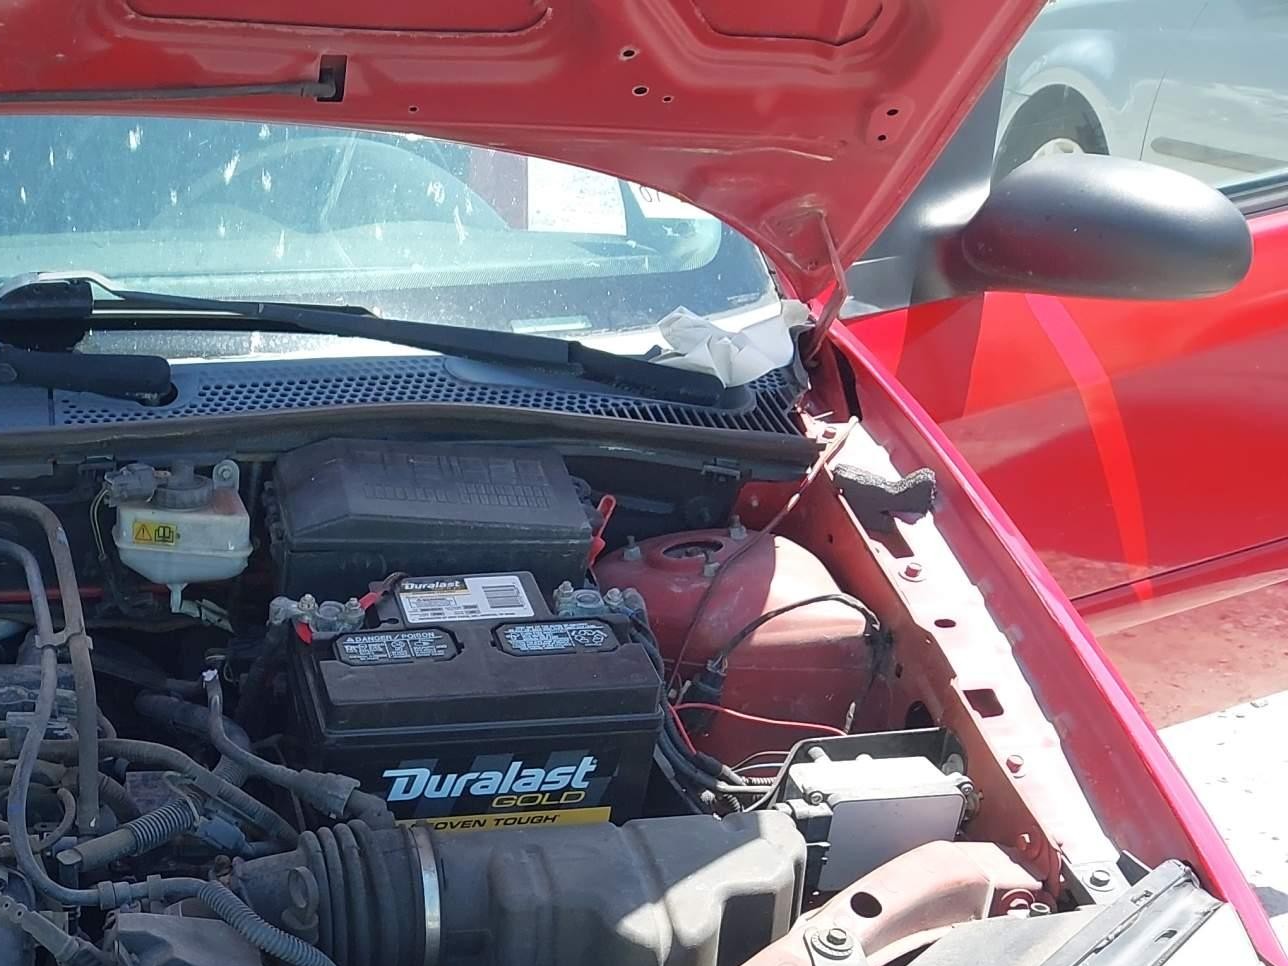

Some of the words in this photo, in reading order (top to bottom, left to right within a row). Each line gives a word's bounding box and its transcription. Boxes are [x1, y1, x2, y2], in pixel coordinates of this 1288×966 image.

[402, 581, 460, 590] Duralast
[355, 634, 392, 643] DANGER
[401, 631, 435, 640] POISON
[383, 756, 597, 801] Duralast
[491, 791, 586, 808] GOLD
[492, 814, 557, 827] TOUGH
